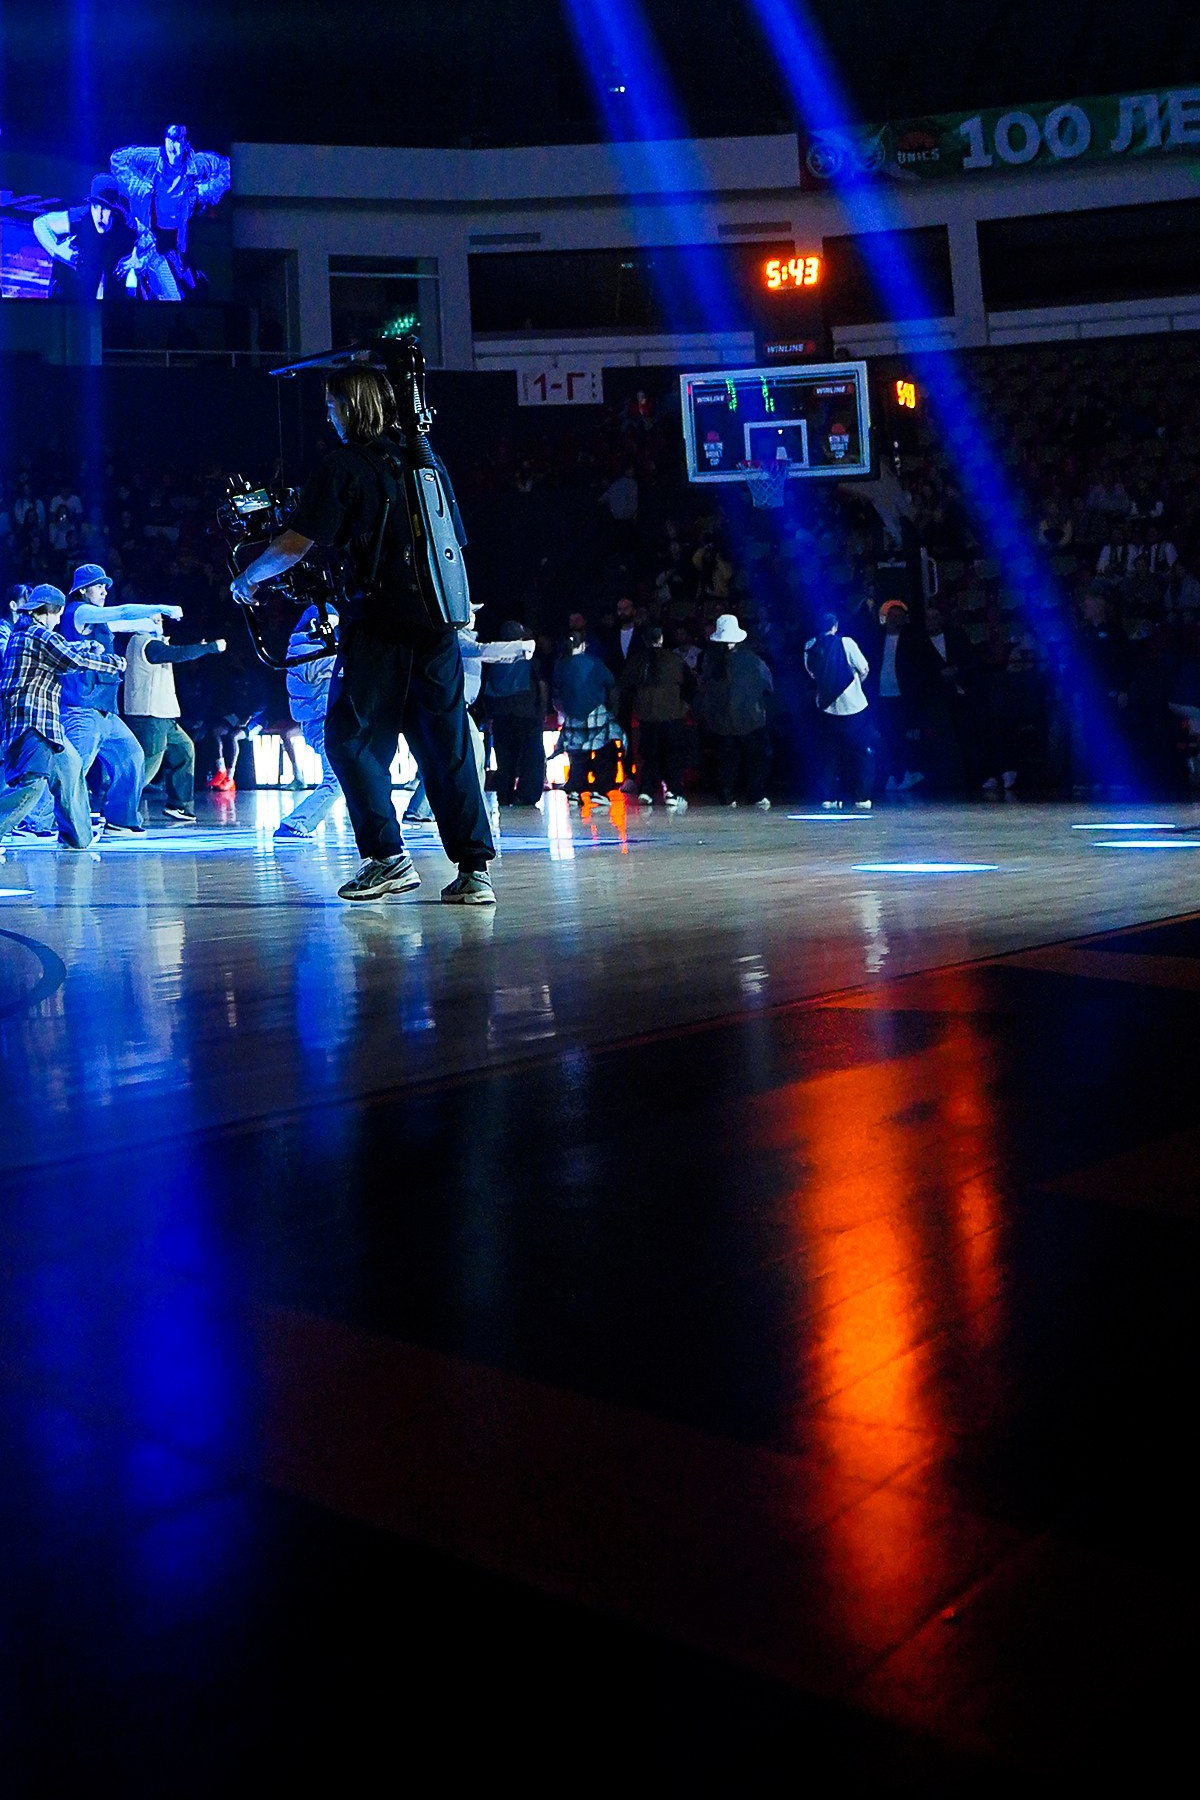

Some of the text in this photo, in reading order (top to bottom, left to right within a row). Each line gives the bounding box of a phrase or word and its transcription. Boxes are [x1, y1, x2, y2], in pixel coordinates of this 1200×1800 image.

[959, 87, 1200, 170] 100 ЛЕ
[766, 257, 819, 289] 5:43
[767, 343, 805, 354] WINLINE
